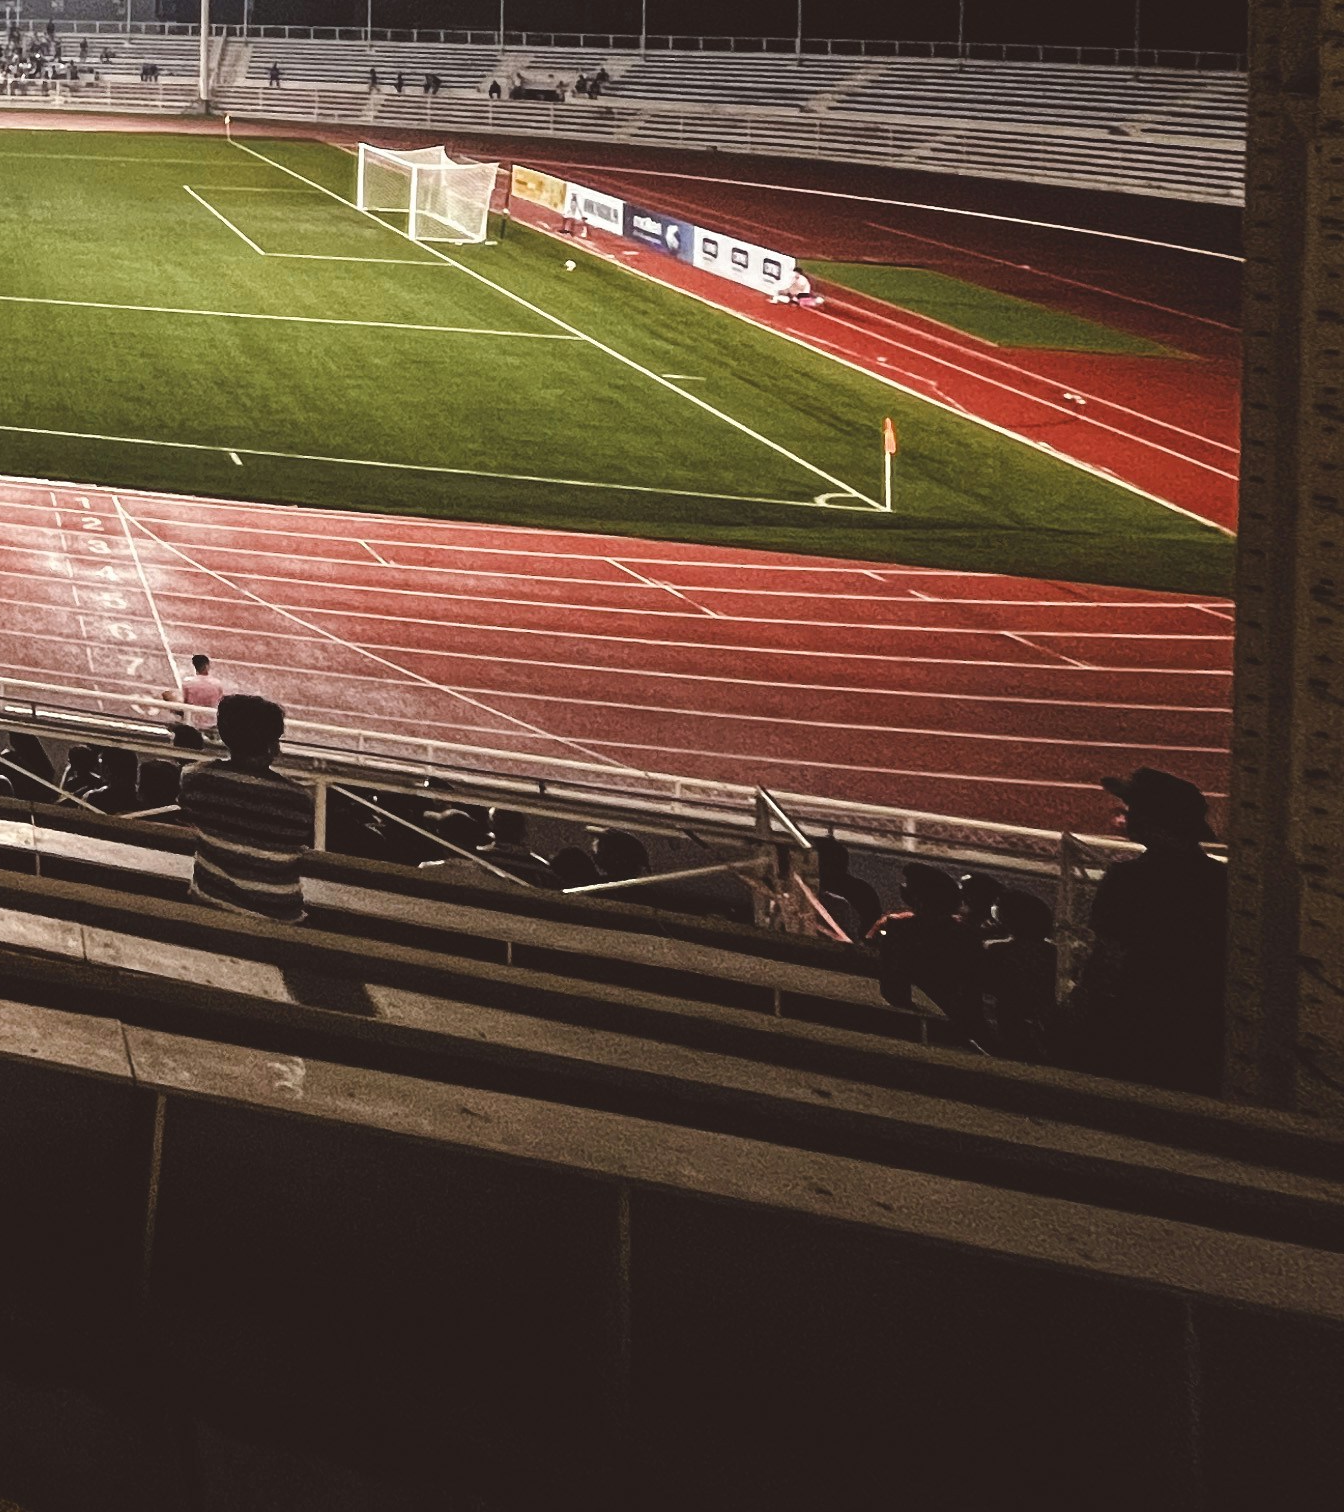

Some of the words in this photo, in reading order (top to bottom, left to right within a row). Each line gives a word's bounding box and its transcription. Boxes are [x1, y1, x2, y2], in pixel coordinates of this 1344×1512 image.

[81, 517, 105, 531] 2
[87, 539, 111, 554] 3
[95, 565, 119, 581] 4
[100, 592, 128, 609] 5
[109, 622, 137, 641] 6
[118, 654, 144, 676] 7
